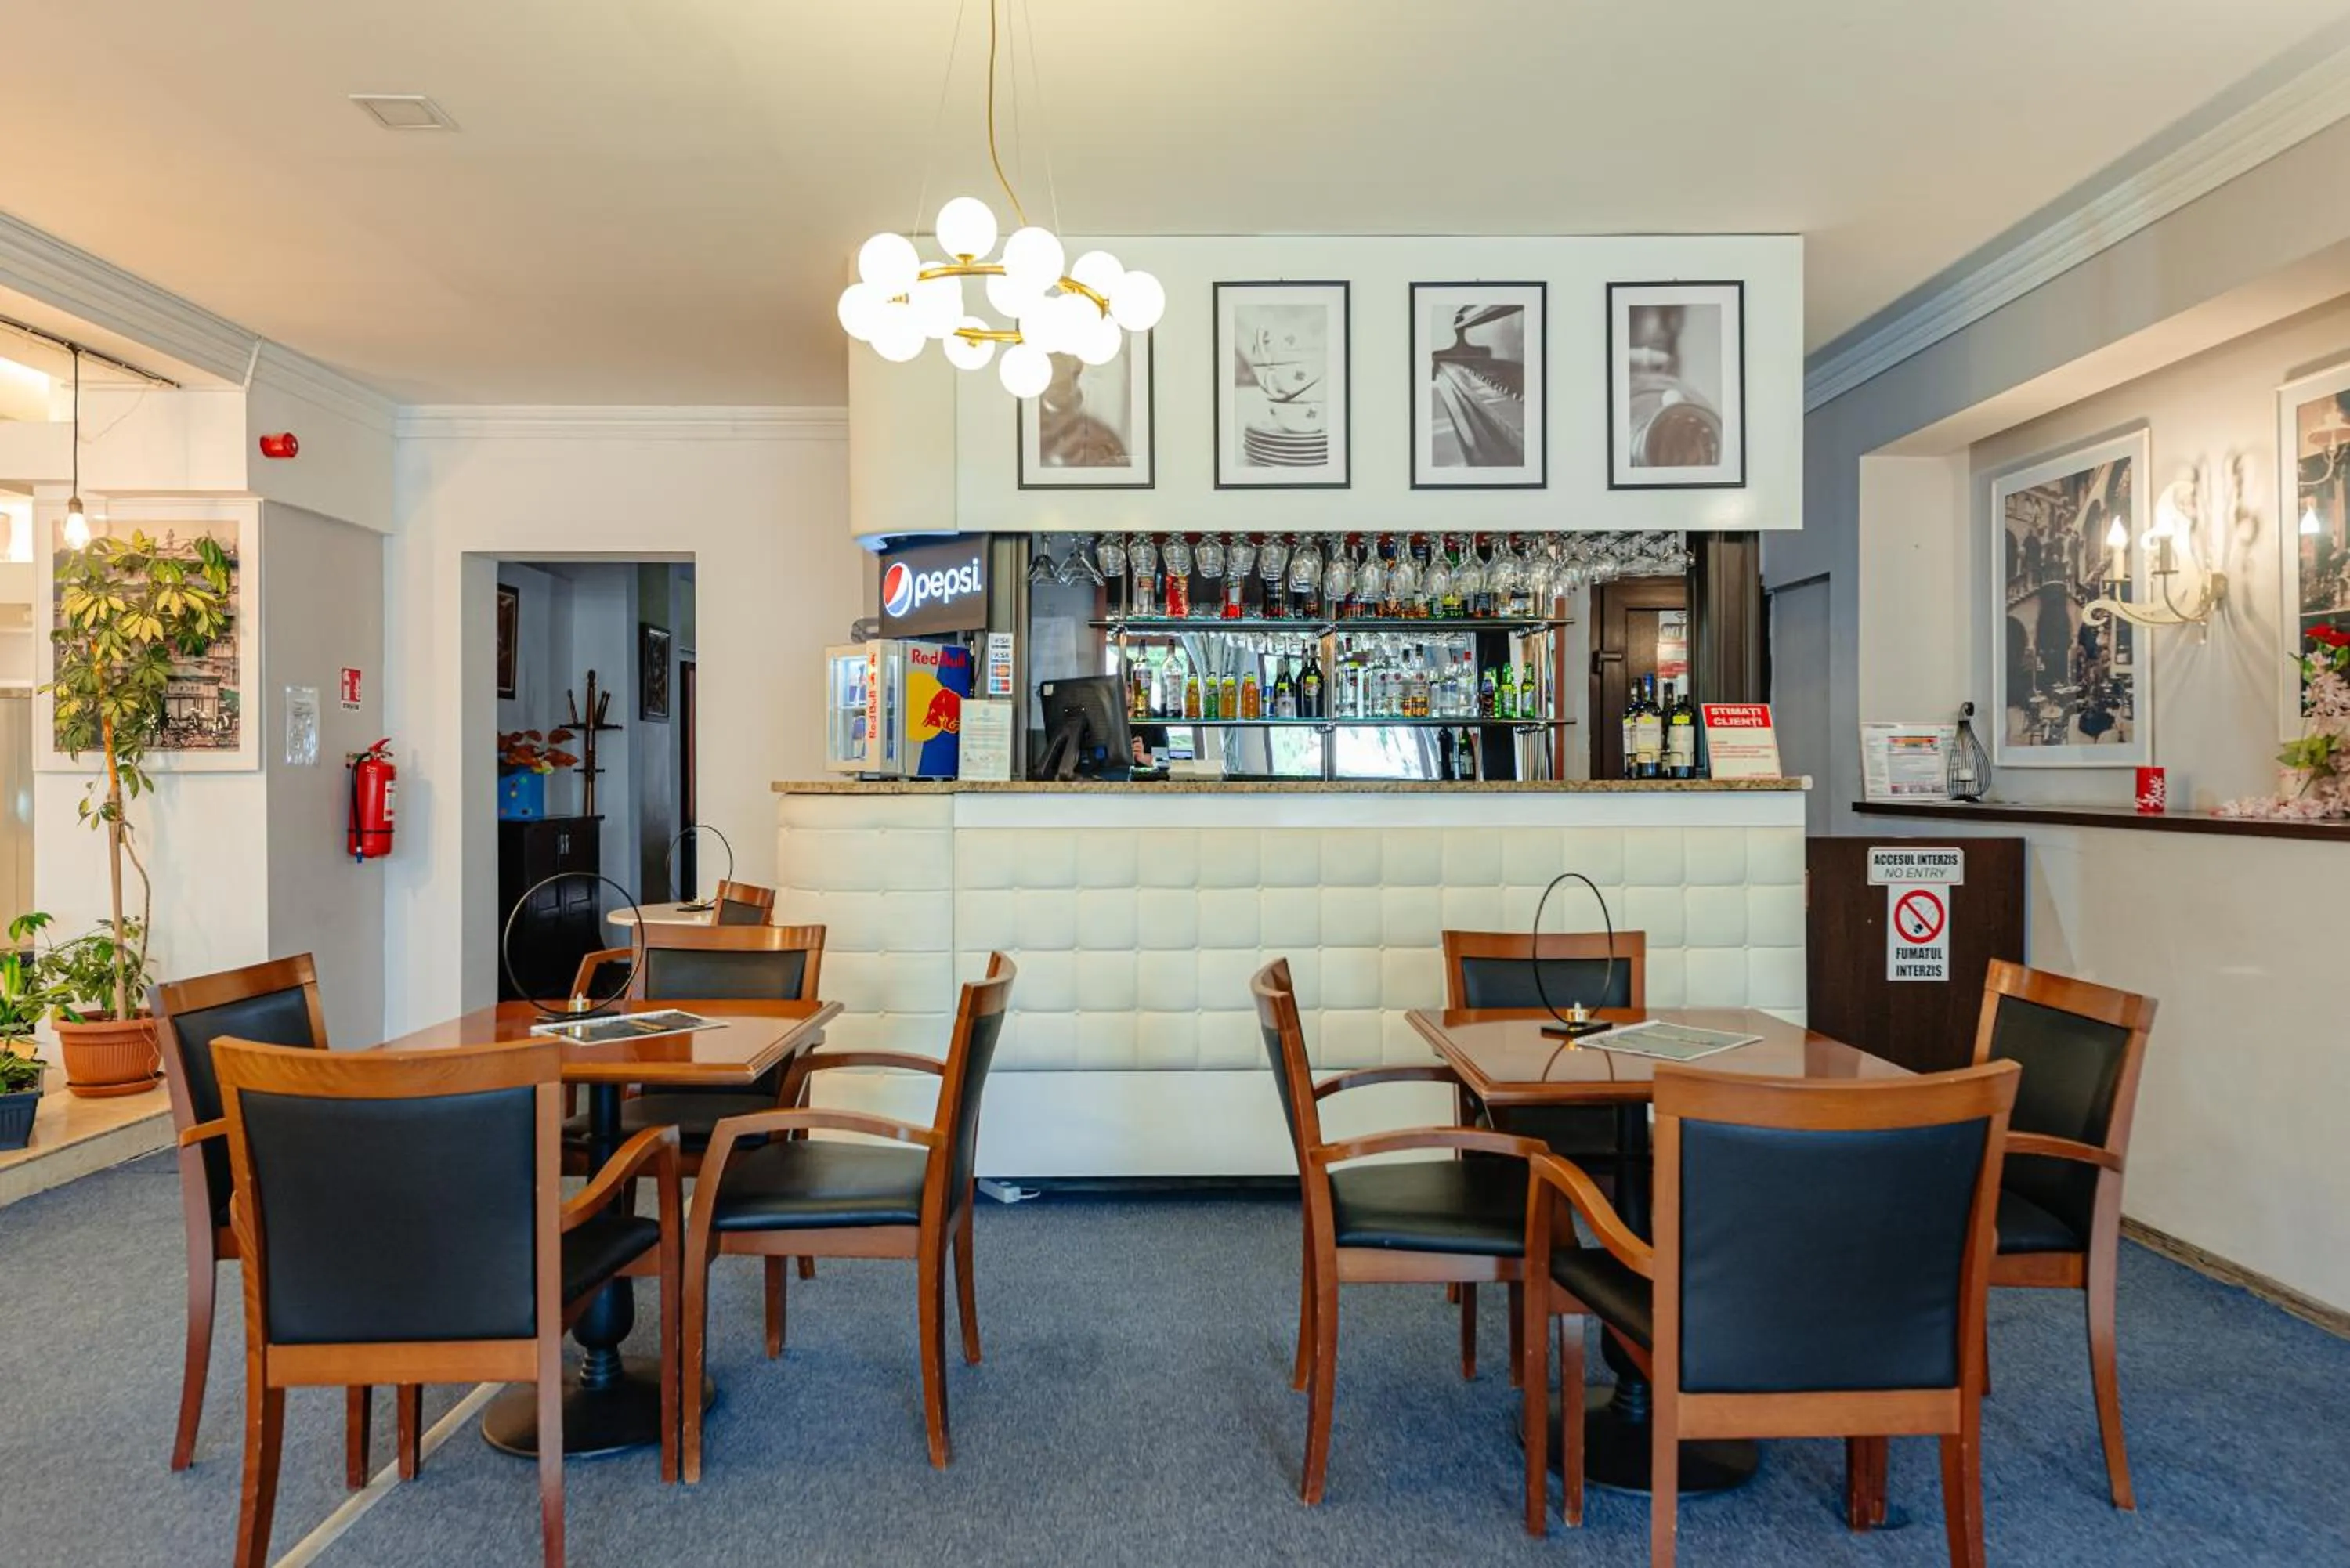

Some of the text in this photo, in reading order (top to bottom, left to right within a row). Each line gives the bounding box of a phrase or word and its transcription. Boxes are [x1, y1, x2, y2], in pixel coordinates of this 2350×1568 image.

[912, 649, 966, 668] Red Bull
[1874, 854, 1958, 865] ACCESUL INTERZIS
[1884, 867, 1947, 878] NO ENTRY
[1896, 947, 1943, 959] FUMATUL
[1896, 964, 1942, 977] INTERZIS
